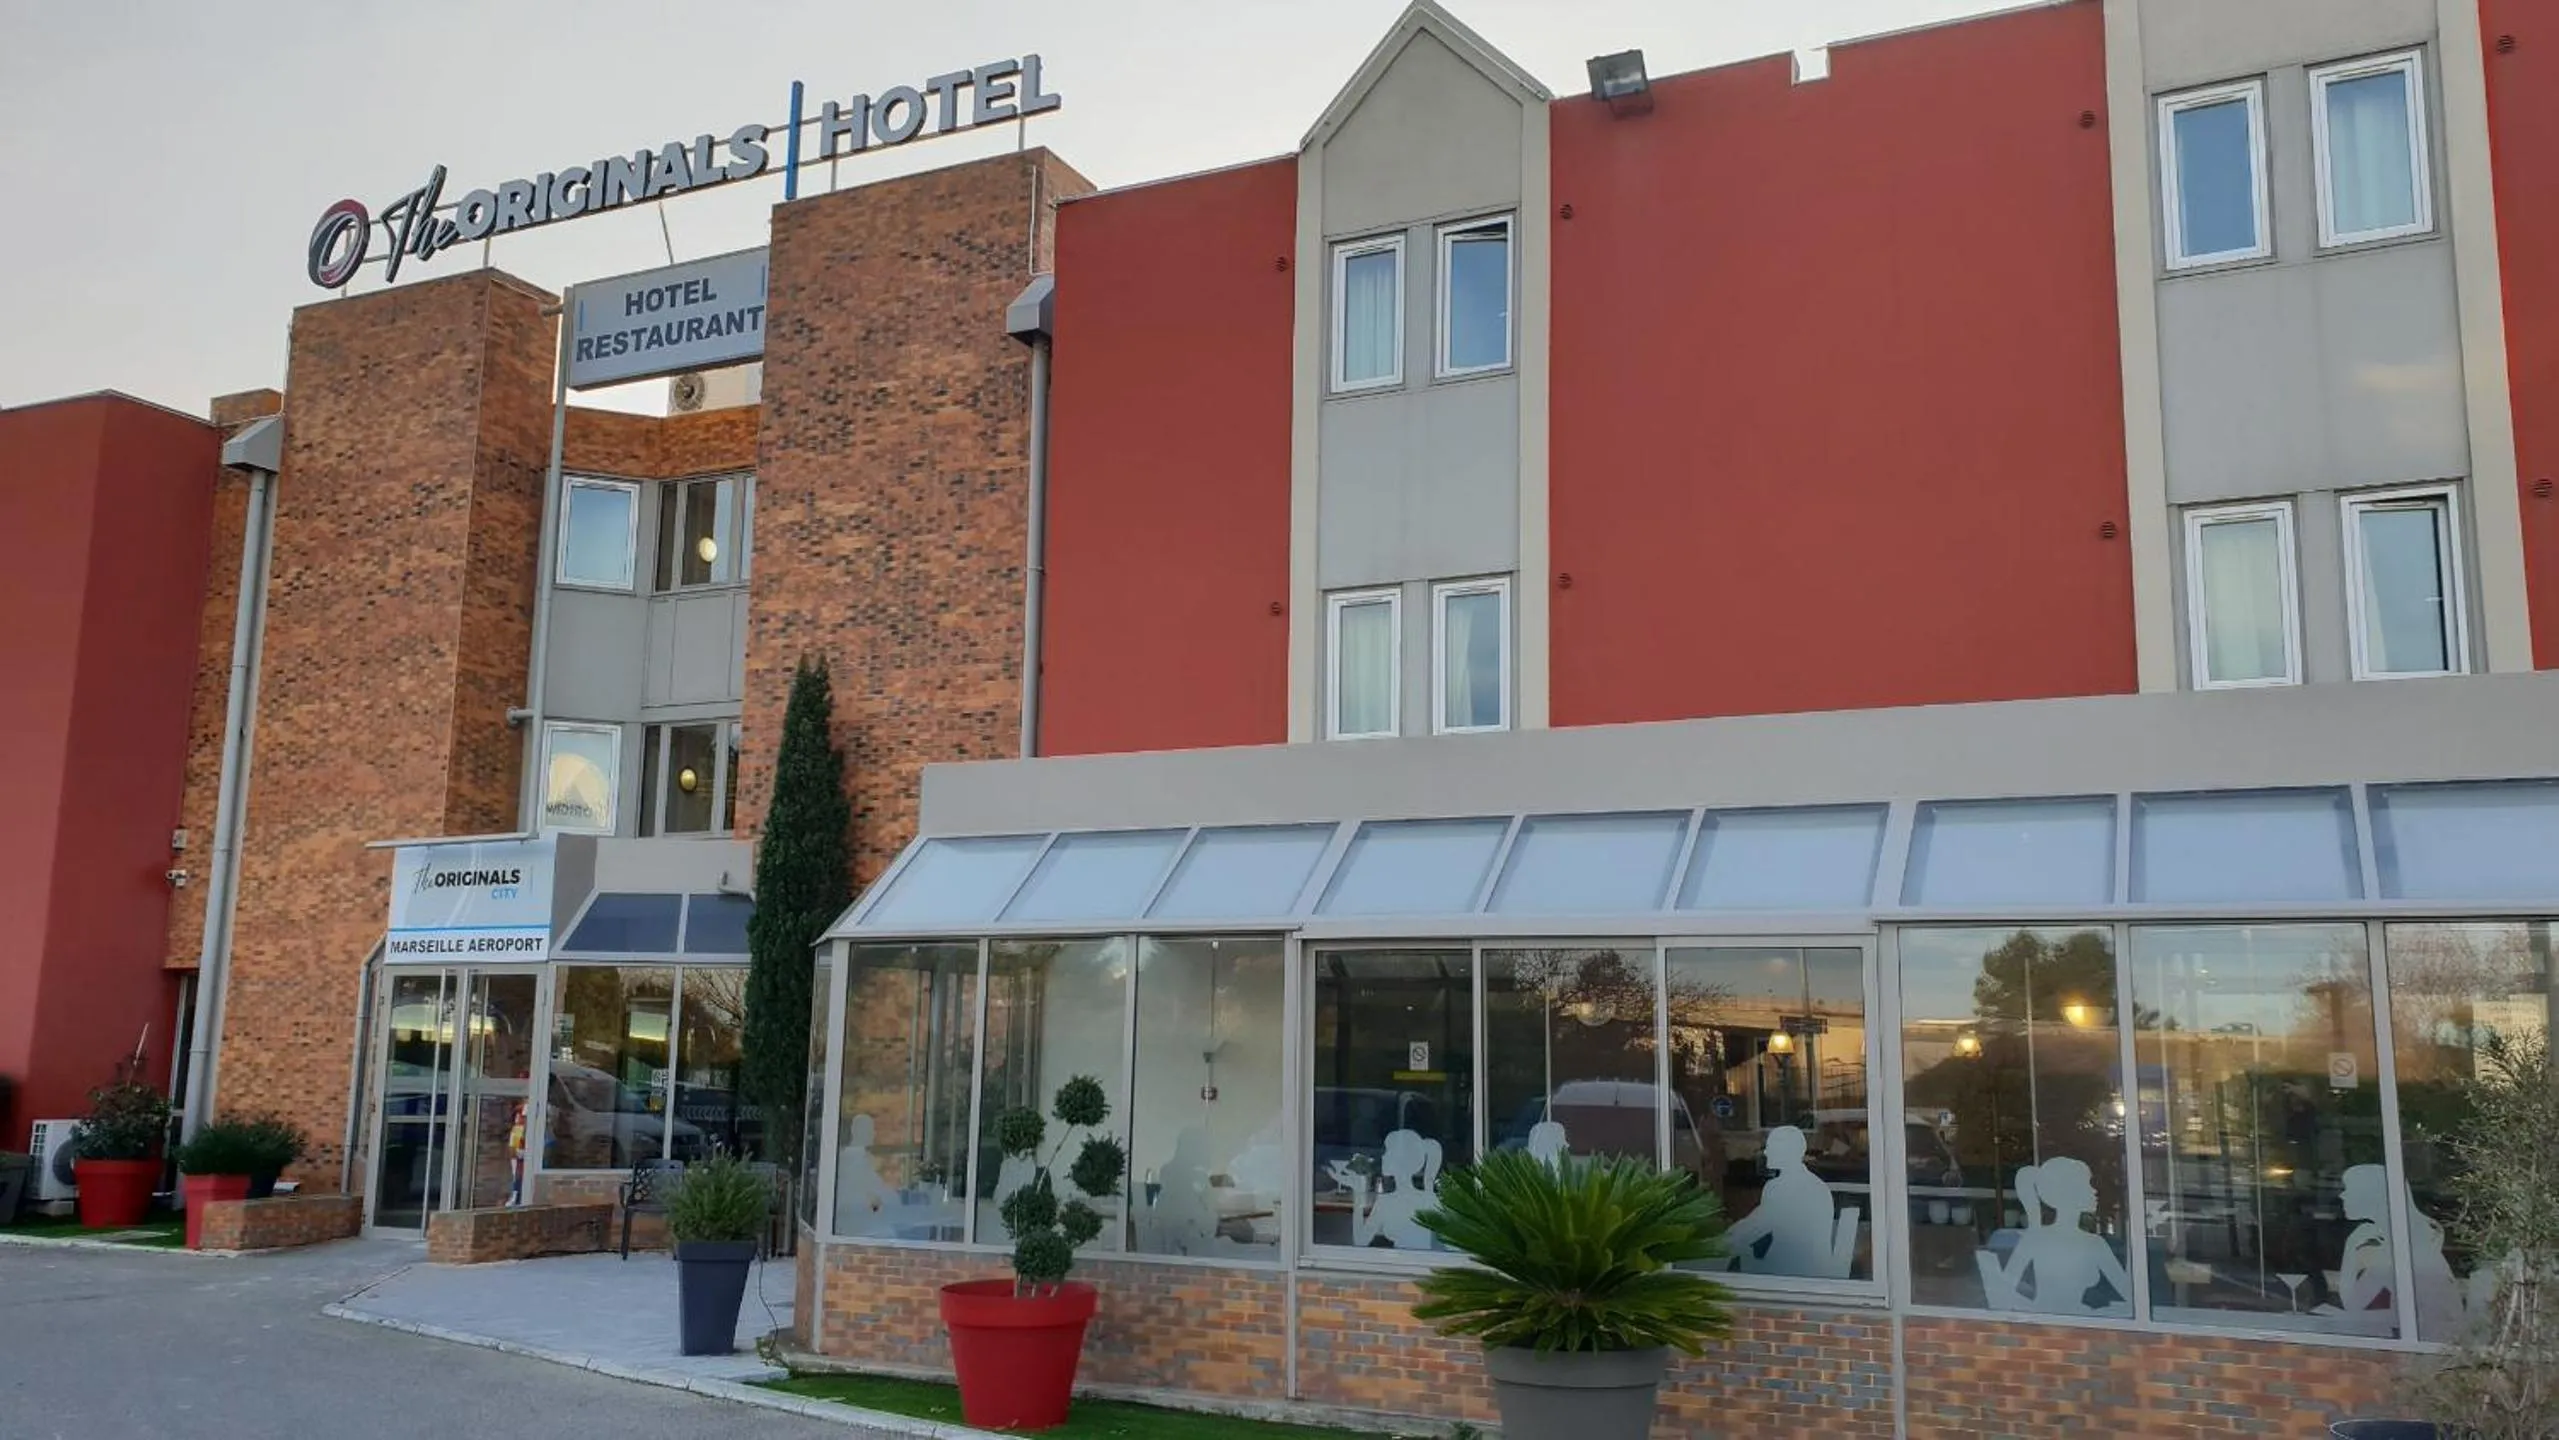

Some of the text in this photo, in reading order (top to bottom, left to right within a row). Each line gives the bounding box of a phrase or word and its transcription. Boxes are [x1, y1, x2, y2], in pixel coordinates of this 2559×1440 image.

[380, 54, 1061, 283] The ORIGINALS HOTEL
[625, 278, 717, 316] HOTEL
[576, 305, 765, 362] RESTAURANT
[415, 863, 521, 894] The ORIGINALS
[491, 887, 519, 900] CITY
[390, 937, 544, 953] MARSEILLE AEROPORT
